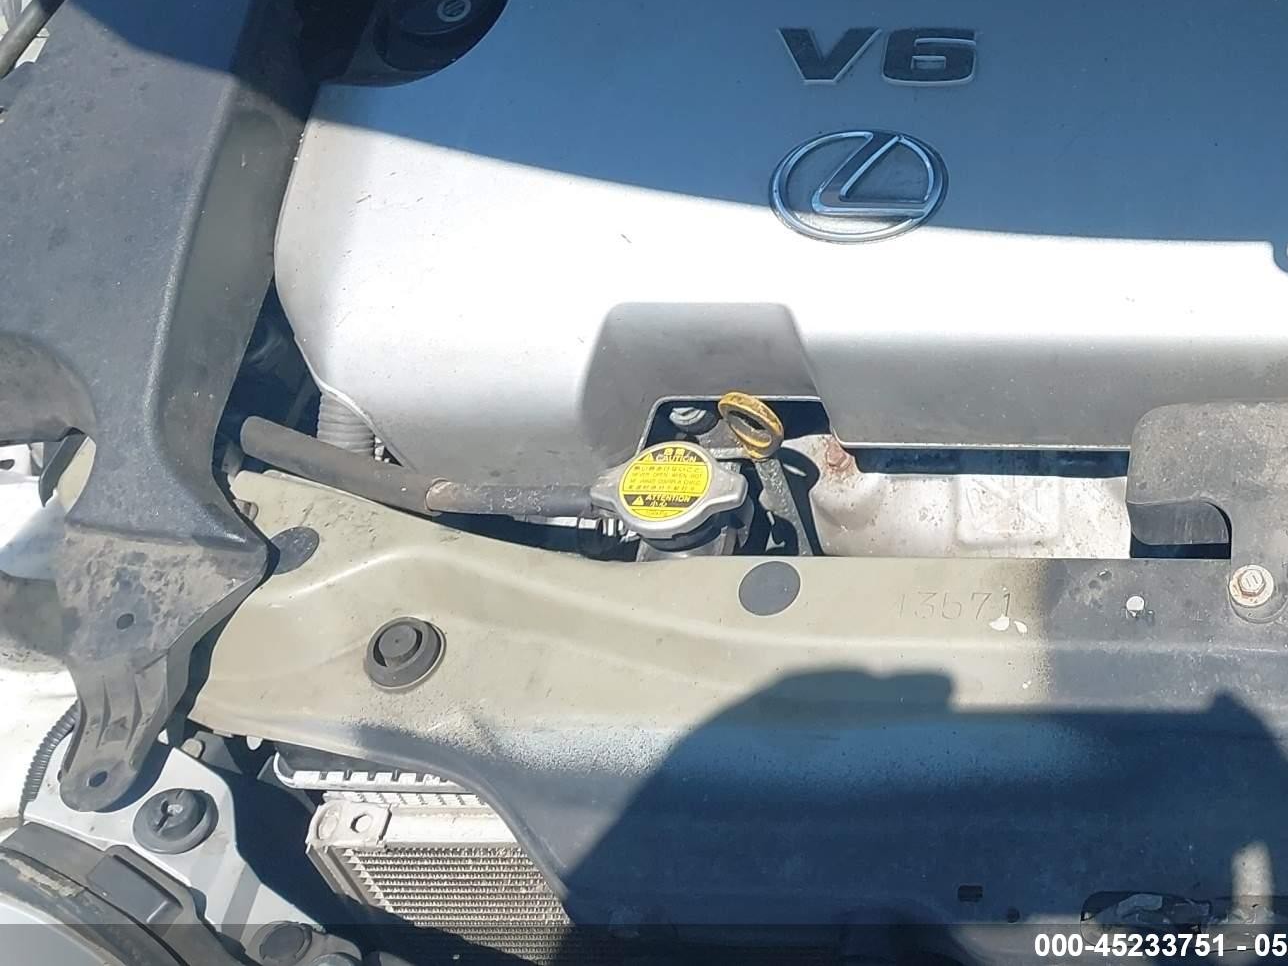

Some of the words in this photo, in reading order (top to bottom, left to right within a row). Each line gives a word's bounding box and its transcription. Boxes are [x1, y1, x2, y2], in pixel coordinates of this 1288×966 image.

[777, 27, 977, 86] V6
[656, 454, 697, 462] CAUTION
[645, 494, 692, 503] ATTENTION
